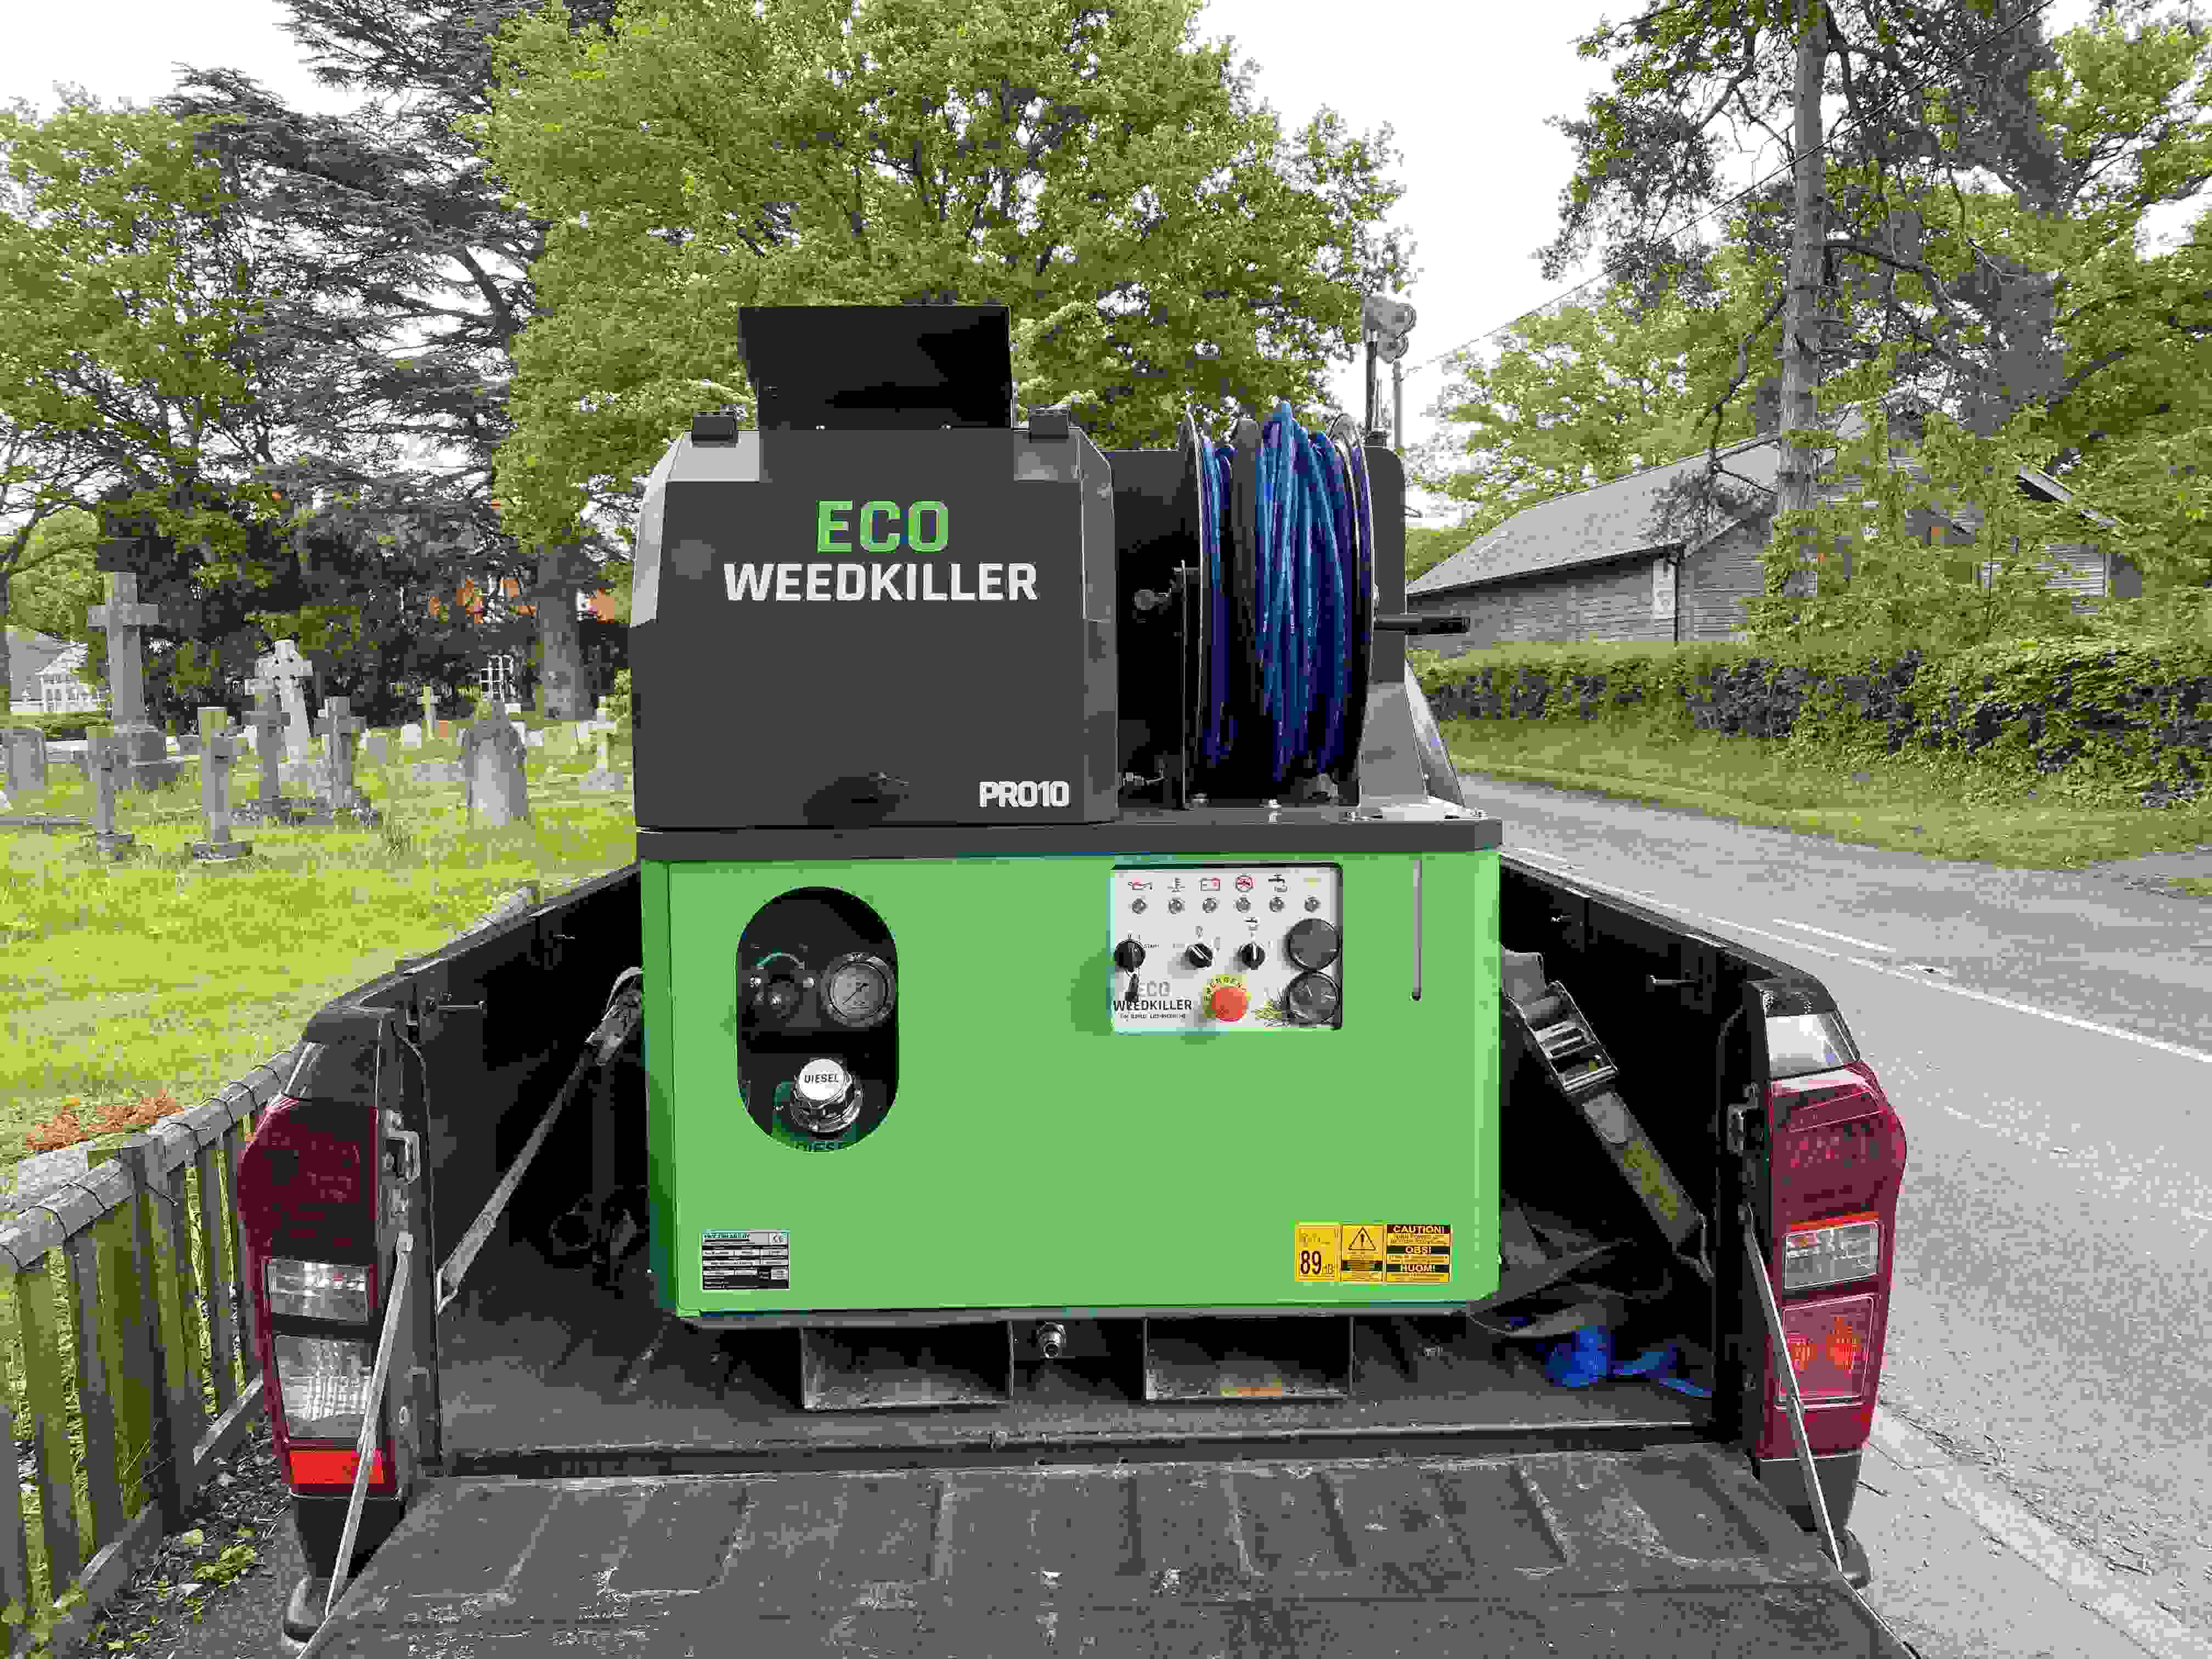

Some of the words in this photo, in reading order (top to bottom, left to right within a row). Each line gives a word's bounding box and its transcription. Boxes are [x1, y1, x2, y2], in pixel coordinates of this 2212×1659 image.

[816, 500, 949, 553] ECO
[724, 563, 1039, 601] WEEDKILLER
[979, 781, 1070, 808] PRO10
[804, 1073, 839, 1084] DIESEL
[1300, 1250, 1322, 1274] 89
